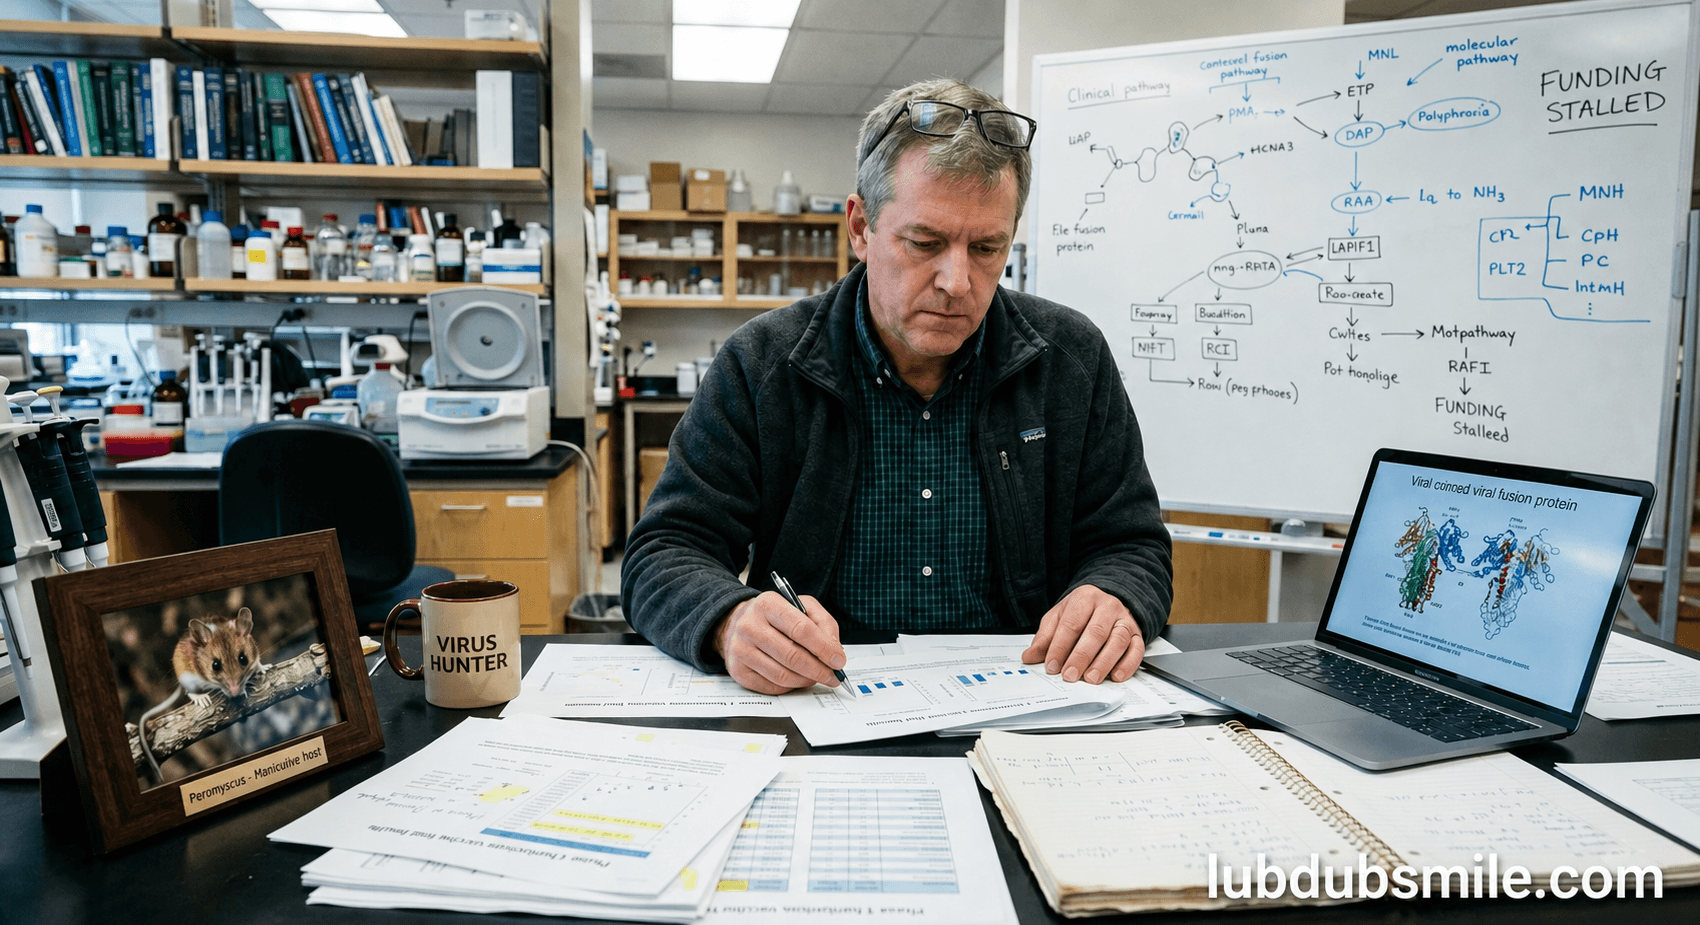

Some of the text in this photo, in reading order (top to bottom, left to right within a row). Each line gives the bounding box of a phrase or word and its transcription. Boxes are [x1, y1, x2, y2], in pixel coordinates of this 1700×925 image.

[1446, 35, 1518, 53] molecular
[1253, 51, 1288, 63] fusion
[1368, 48, 1399, 61] MNL
[1456, 52, 1519, 72] pathway
[1220, 67, 1268, 83] pathway
[1540, 60, 1667, 97] FUNDING
[1067, 80, 1171, 103] Clinical pathway
[1347, 83, 1375, 97] ETP
[1546, 91, 1666, 123] STALLED
[1345, 126, 1374, 141] DAP
[1344, 195, 1374, 208] RAA
[1446, 188, 1462, 200] to
[1579, 183, 1624, 202] MNH
[1073, 222, 1107, 235] fusion
[1056, 241, 1095, 257] protein
[1489, 261, 1527, 276] PLT2
[1431, 324, 1516, 347] Motpathway
[1435, 396, 1507, 422] FUNDING
[1453, 420, 1510, 443] Stalleed
[1411, 475, 1433, 489] Viral
[1473, 485, 1498, 499] viral
[1497, 488, 1533, 505] fusion
[1533, 495, 1579, 512] protein
[436, 634, 497, 653] VIRUS
[430, 652, 508, 674] HUNTER
[188, 775, 247, 804] Peromyscus
[302, 747, 322, 762] host
